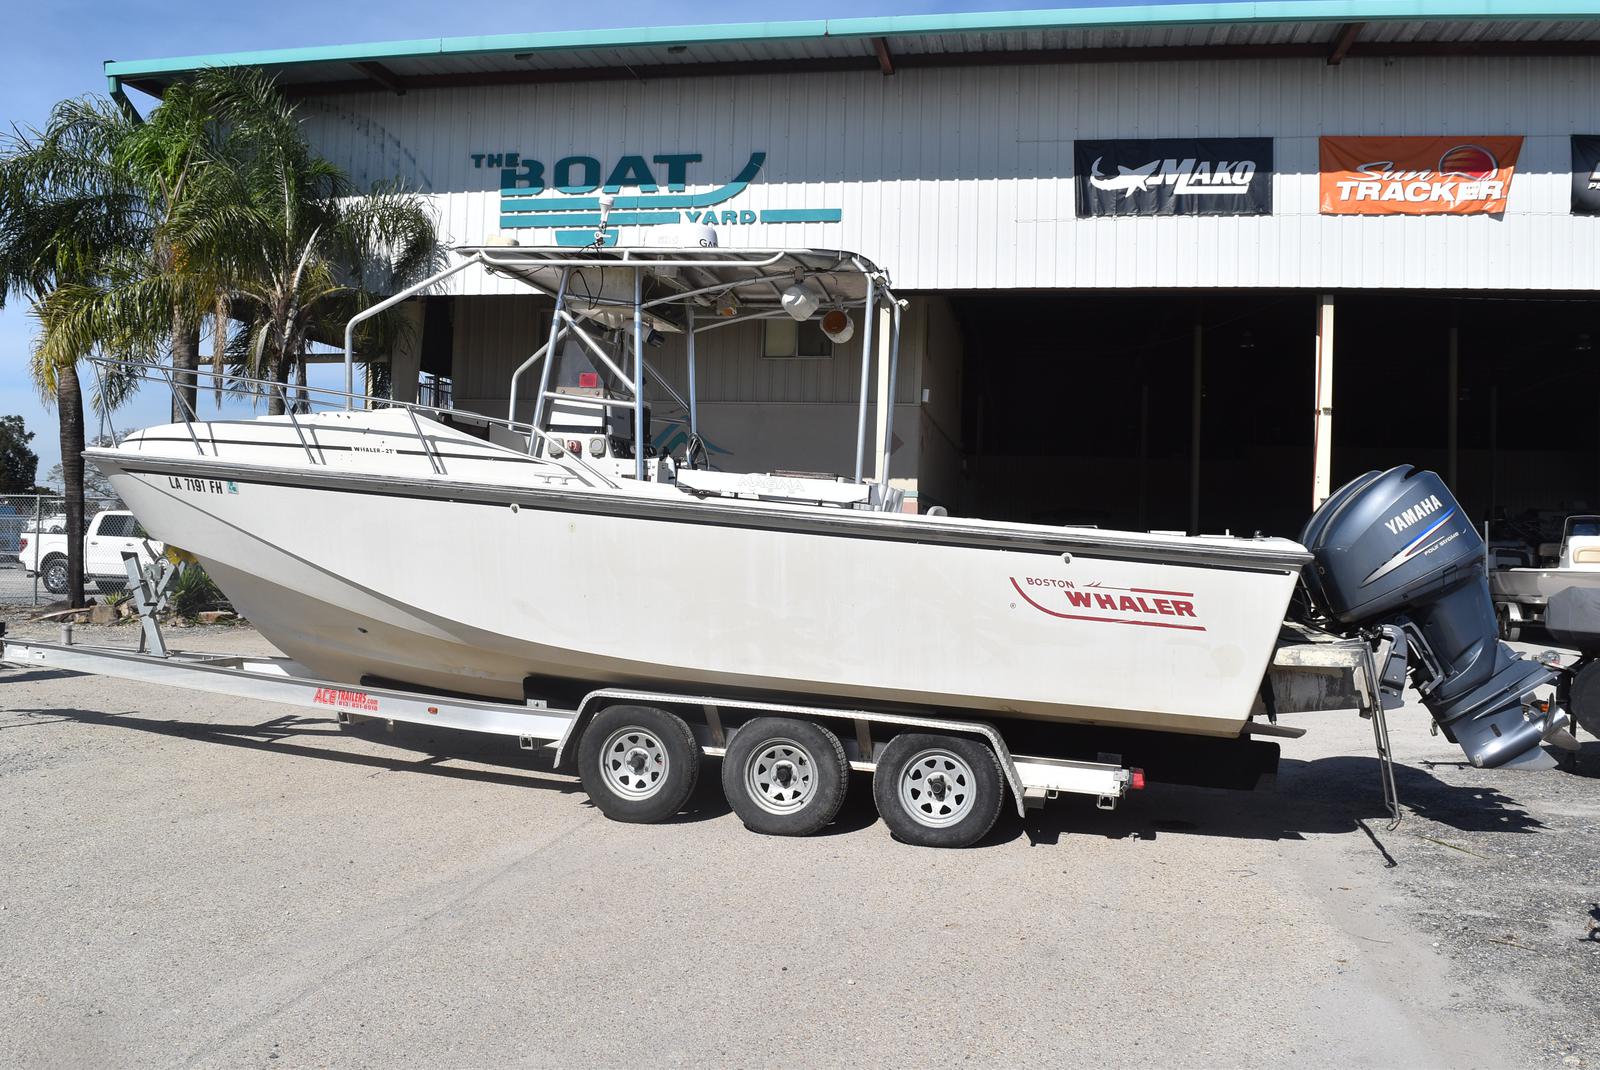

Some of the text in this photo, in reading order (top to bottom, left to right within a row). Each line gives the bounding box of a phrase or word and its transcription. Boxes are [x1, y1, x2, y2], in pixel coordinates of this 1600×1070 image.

[471, 153, 520, 168] THE
[500, 154, 702, 196] BOAT
[1146, 158, 1257, 195] MAKO
[1347, 161, 1436, 182] Sun
[1336, 181, 1505, 202] TRACKER
[685, 210, 756, 224] YARD
[168, 476, 182, 490] LA
[184, 478, 206, 493] 7191
[209, 480, 223, 494] FH
[1384, 494, 1443, 535] YAMAHA
[1026, 577, 1075, 589] BOSTON
[1064, 590, 1197, 617] WHALER
[313, 687, 337, 704] ACE
